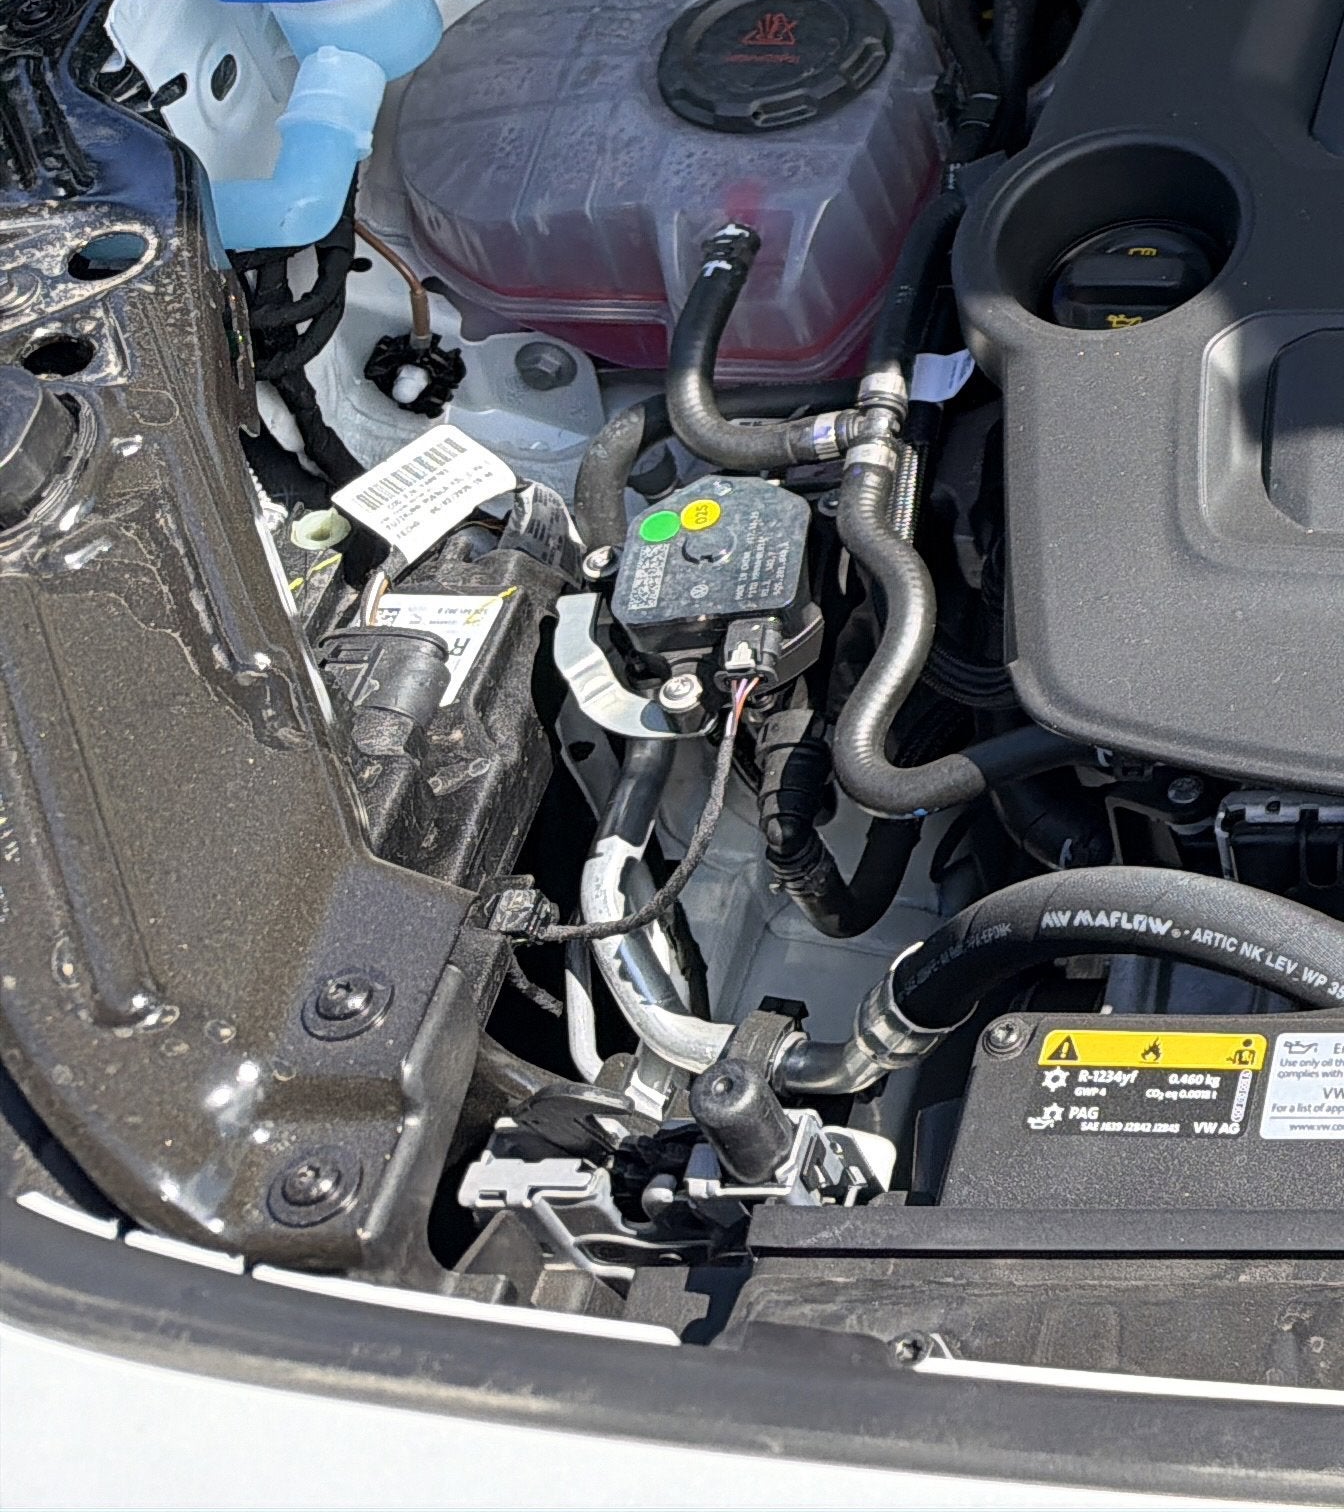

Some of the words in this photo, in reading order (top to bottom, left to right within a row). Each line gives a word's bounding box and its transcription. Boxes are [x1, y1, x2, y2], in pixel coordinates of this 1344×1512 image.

[1191, 929, 1238, 953] ARTIC
[1239, 941, 1264, 963] NK
[1279, 1058, 1298, 1068] Use
[1299, 1058, 1320, 1069] only
[1321, 1058, 1333, 1068] oil
[1076, 1070, 1140, 1087] R-1234yf
[1168, 1073, 1205, 1086] 0.460
[1205, 1074, 1221, 1089] kg
[1277, 1070, 1319, 1079] complies
[1321, 1070, 1344, 1079] with
[1068, 1105, 1100, 1120] PAG
[1271, 1103, 1287, 1113] For
[1296, 1103, 1311, 1113] list
[1313, 1103, 1325, 1113] of
[1193, 1122, 1217, 1134] VW
[1217, 1122, 1241, 1135] AG
